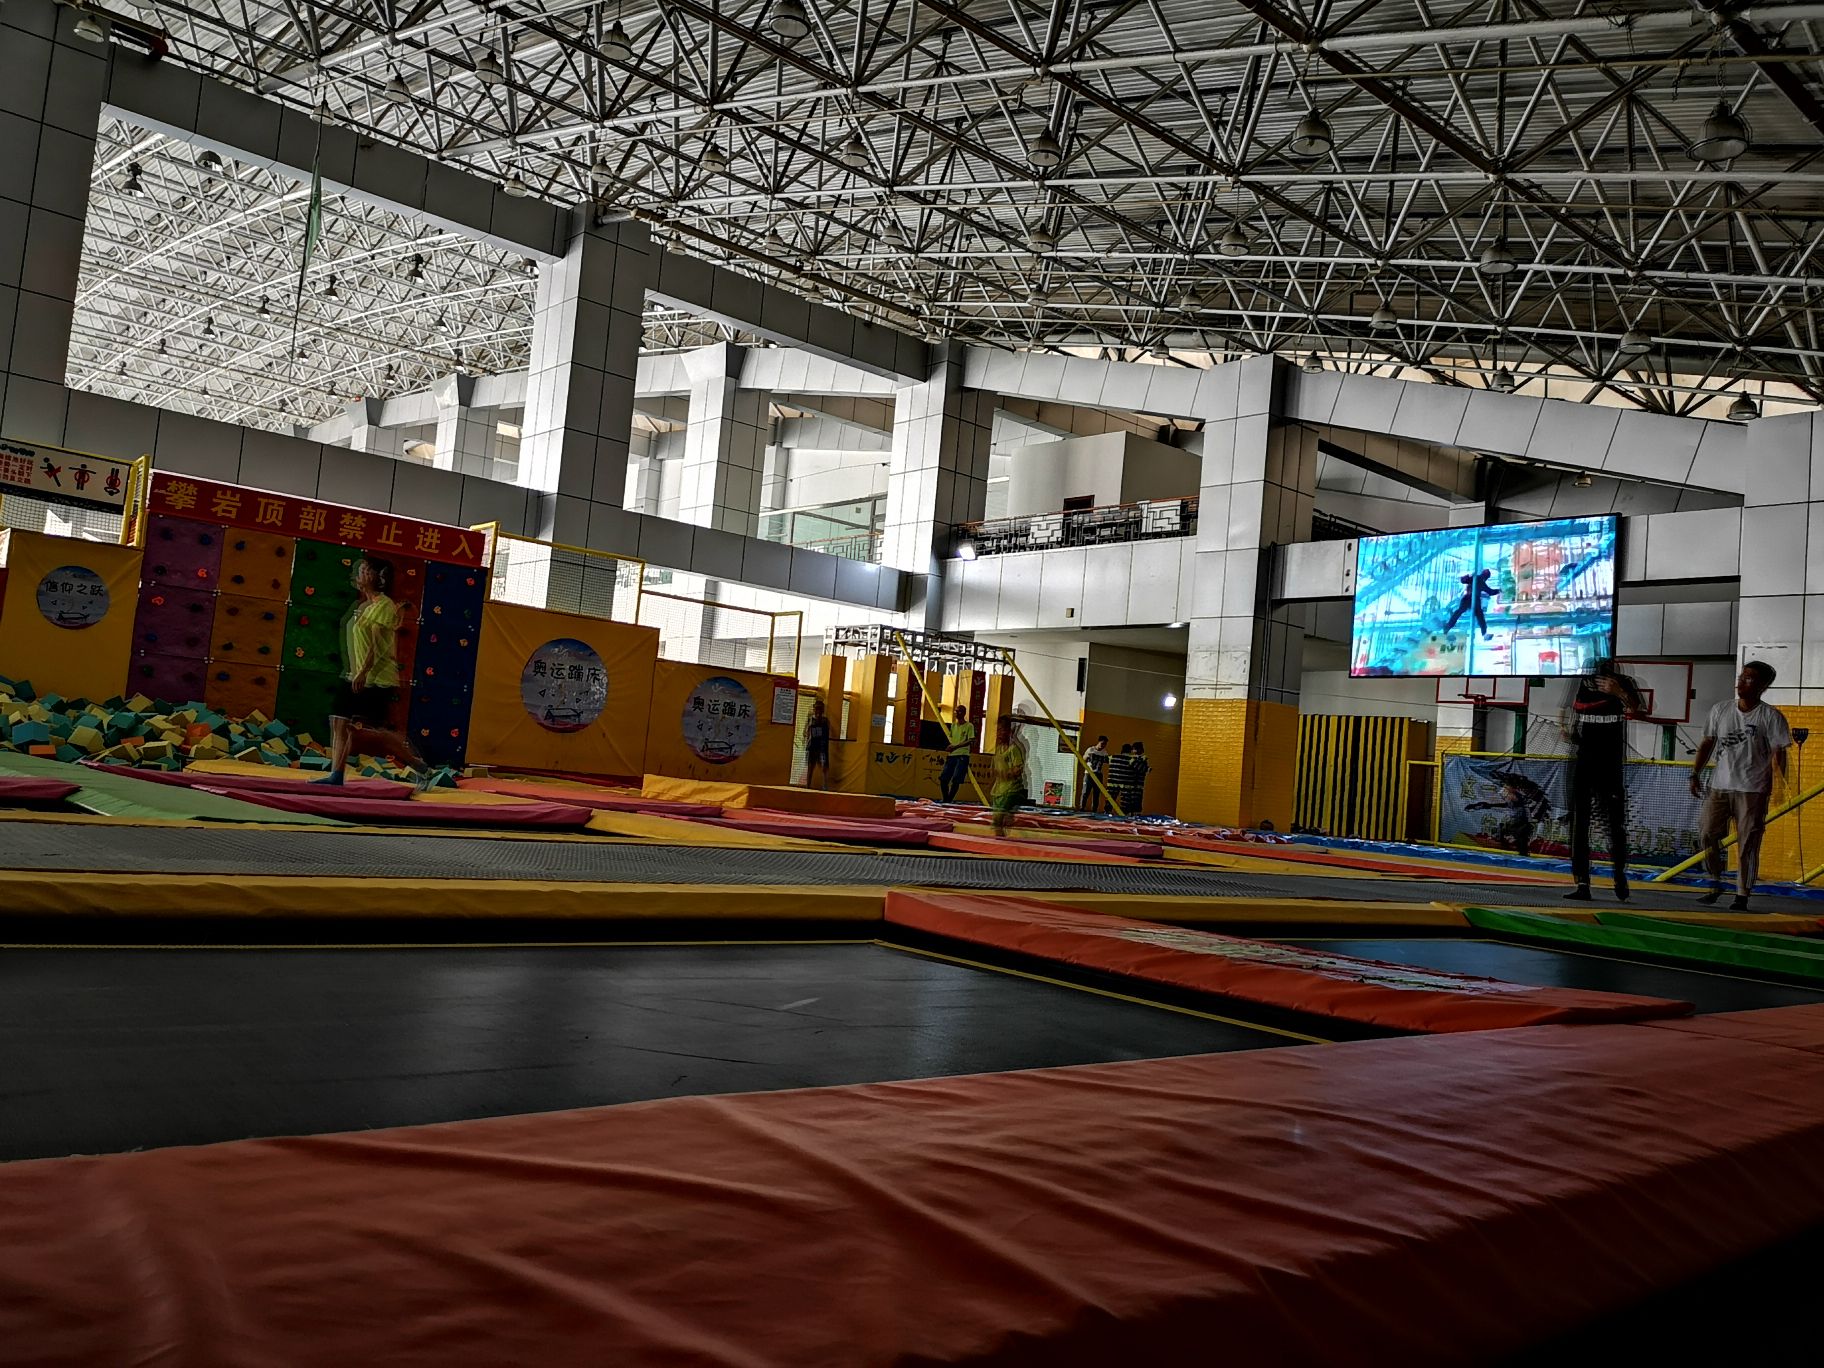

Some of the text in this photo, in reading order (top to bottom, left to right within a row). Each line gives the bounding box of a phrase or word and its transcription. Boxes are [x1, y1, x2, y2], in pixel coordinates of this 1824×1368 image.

[165, 480, 475, 560] 攀岩顶部禁止进入
[45, 578, 104, 597] 信仰之跃
[532, 659, 603, 684] 奥运蹦床
[691, 695, 751, 720] 奥运蹦床
